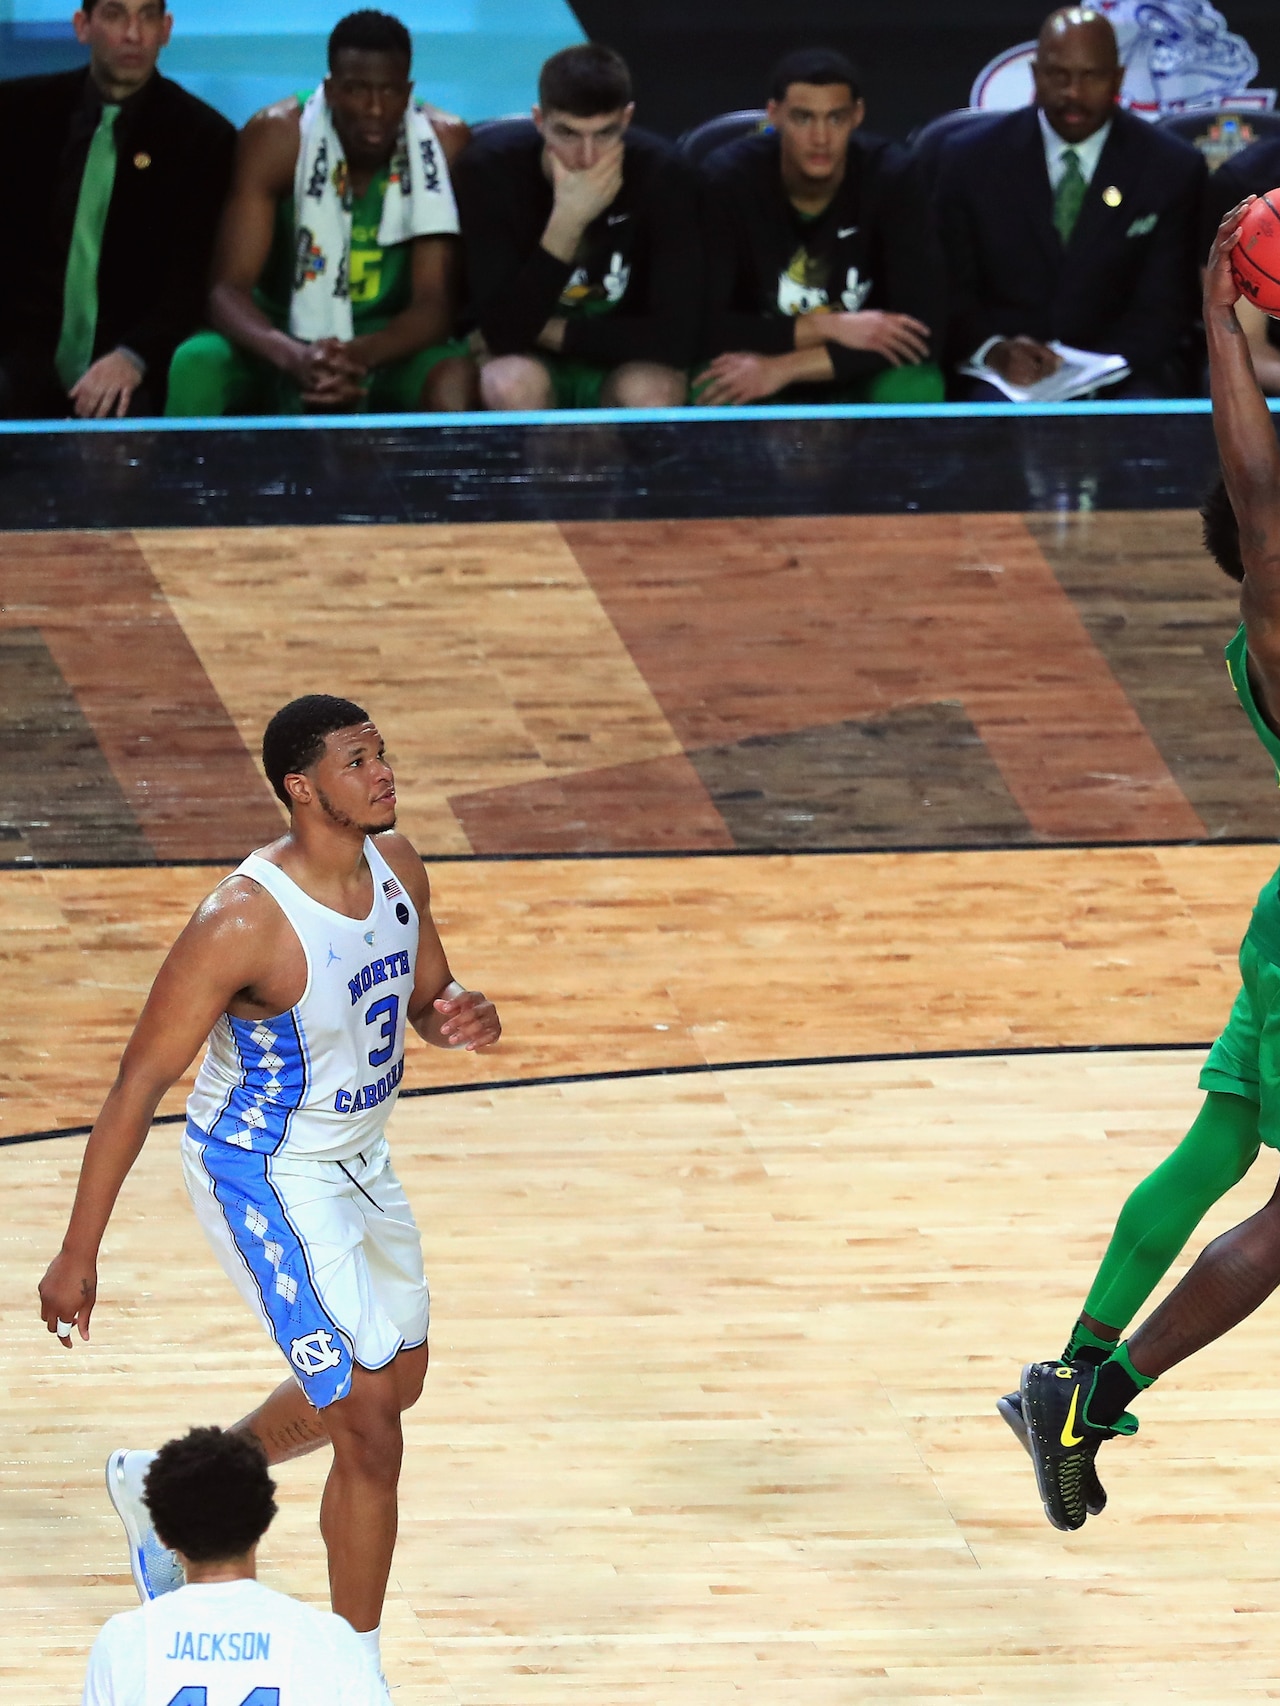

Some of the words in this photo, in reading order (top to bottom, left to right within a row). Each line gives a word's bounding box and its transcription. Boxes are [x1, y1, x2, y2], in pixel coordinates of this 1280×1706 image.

[347, 949, 411, 1006] NORTH
[365, 993, 400, 1067] 3
[165, 1631, 270, 1661] JACKSON
